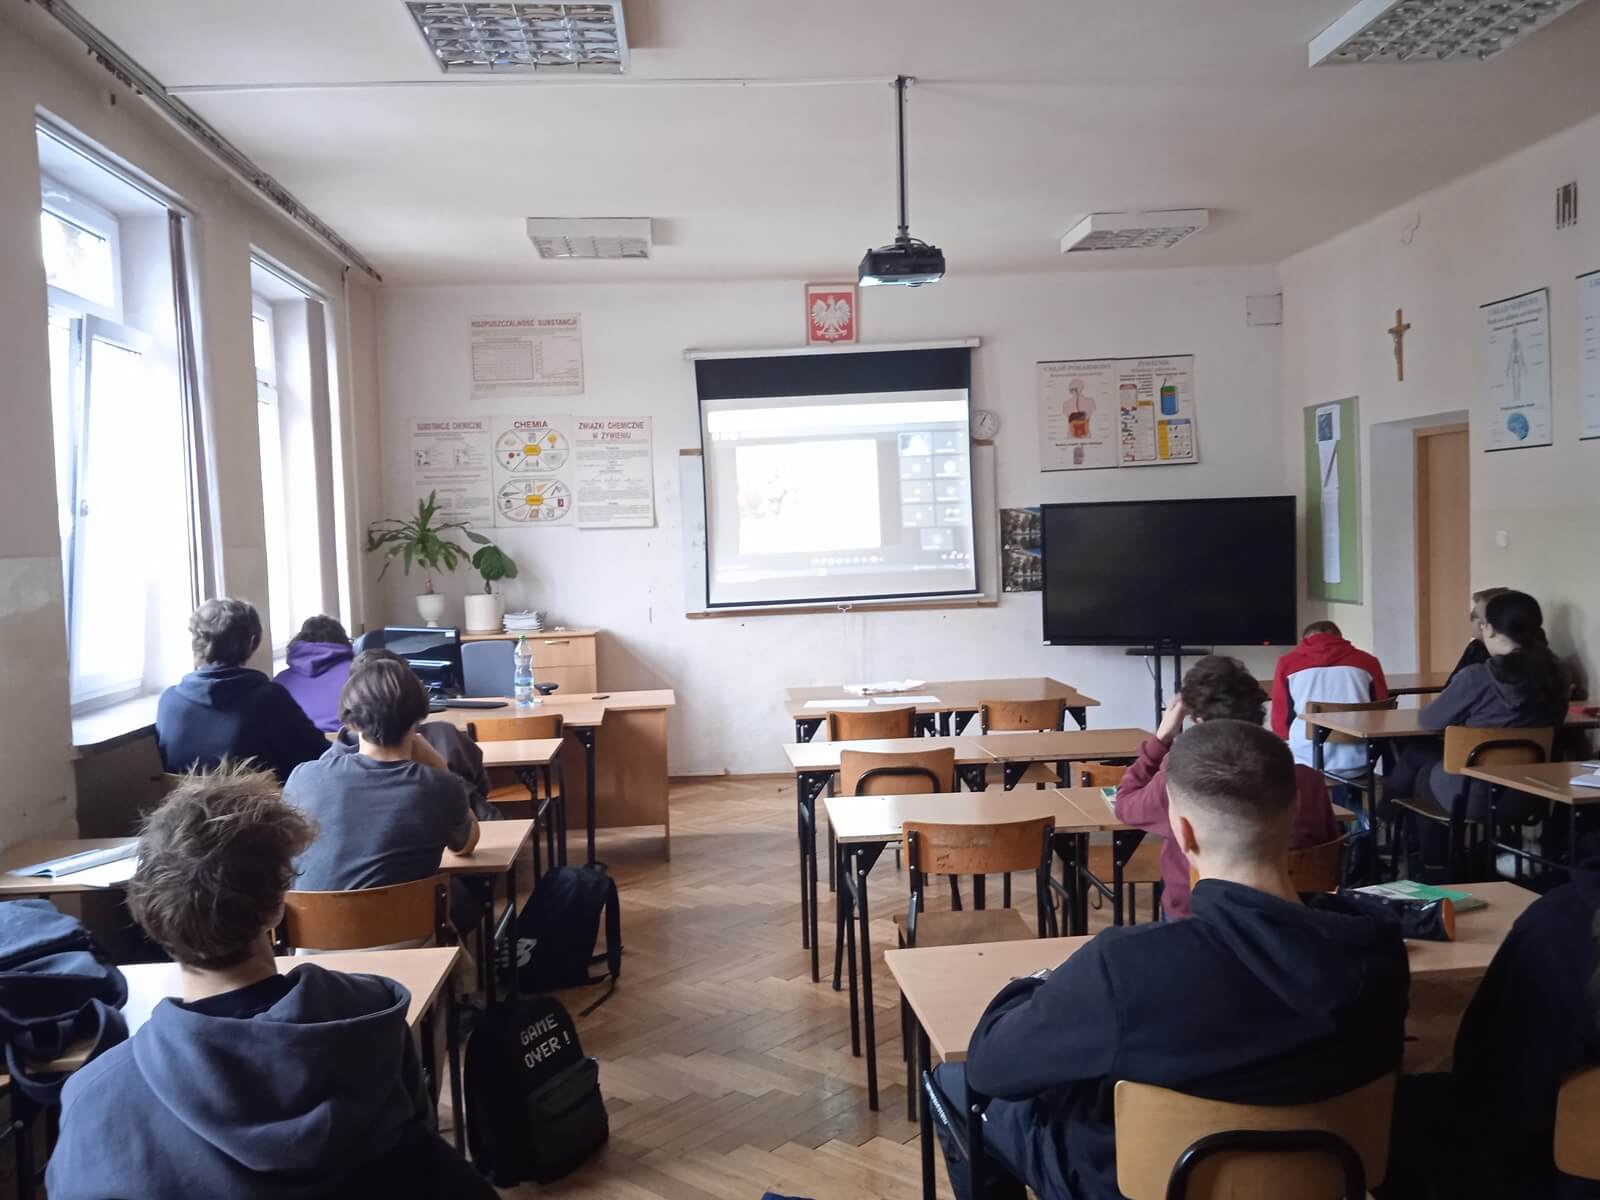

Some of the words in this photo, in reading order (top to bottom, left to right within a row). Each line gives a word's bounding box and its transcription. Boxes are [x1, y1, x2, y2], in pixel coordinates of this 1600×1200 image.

[513, 420, 548, 429] CHEMIA
[607, 421, 645, 429] CHEMICZNE
[520, 1012, 559, 1046] GAME
